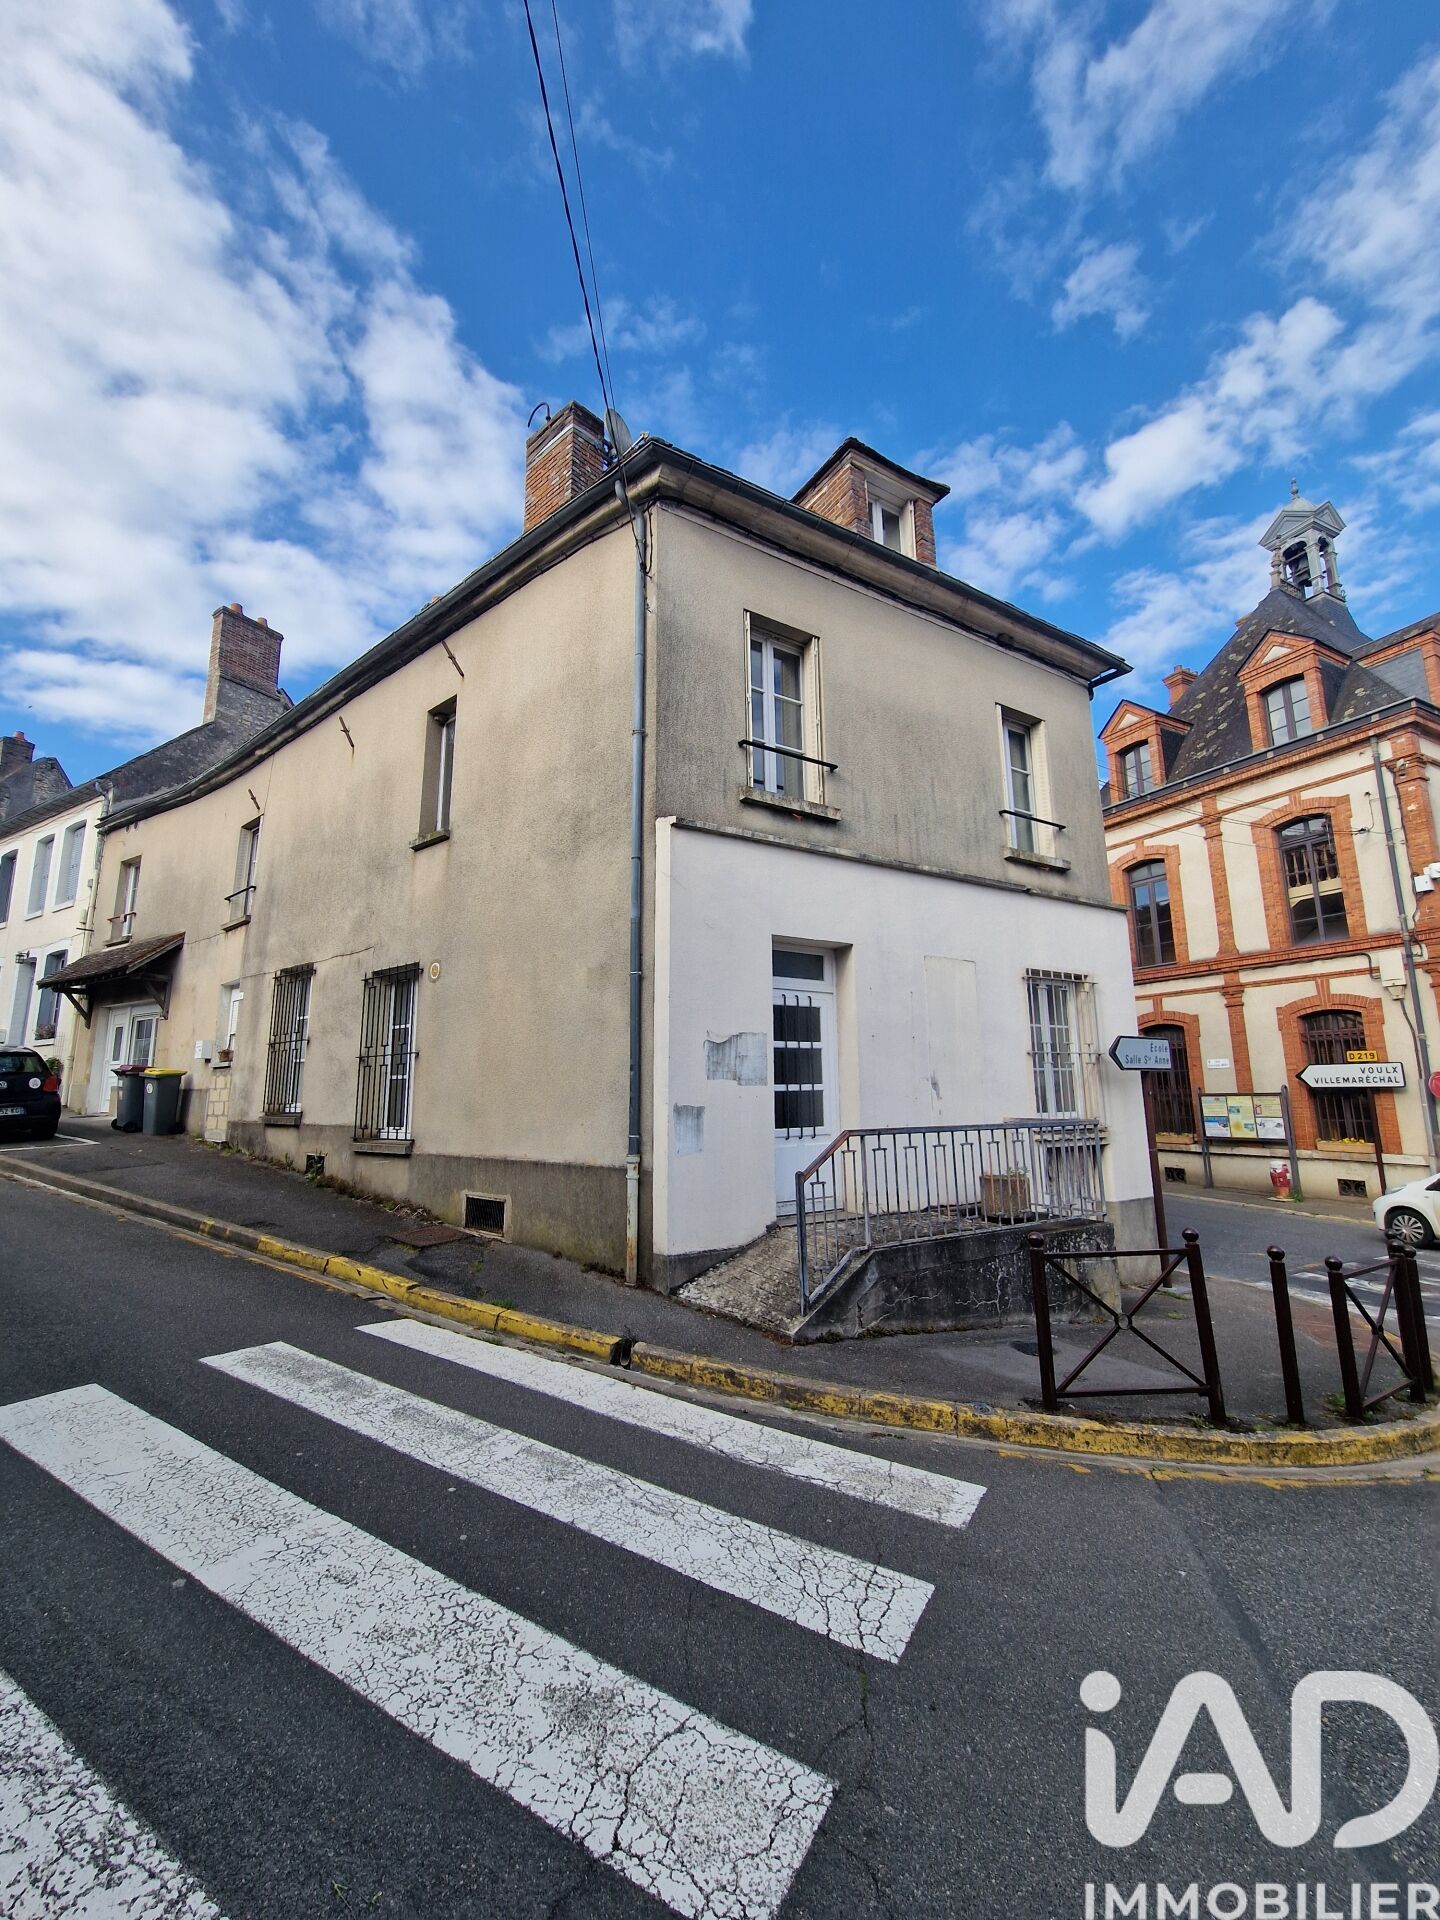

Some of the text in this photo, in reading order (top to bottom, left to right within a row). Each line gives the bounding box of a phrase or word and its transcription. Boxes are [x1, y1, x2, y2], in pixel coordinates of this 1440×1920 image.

[1125, 1054, 1141, 1064] Salle
[1154, 1055, 1169, 1064] Anne
[1357, 1052, 1375, 1060] 219
[1360, 1066, 1398, 1074] VOULX
[1314, 1075, 1400, 1084] VILLEMARÉCHAL
